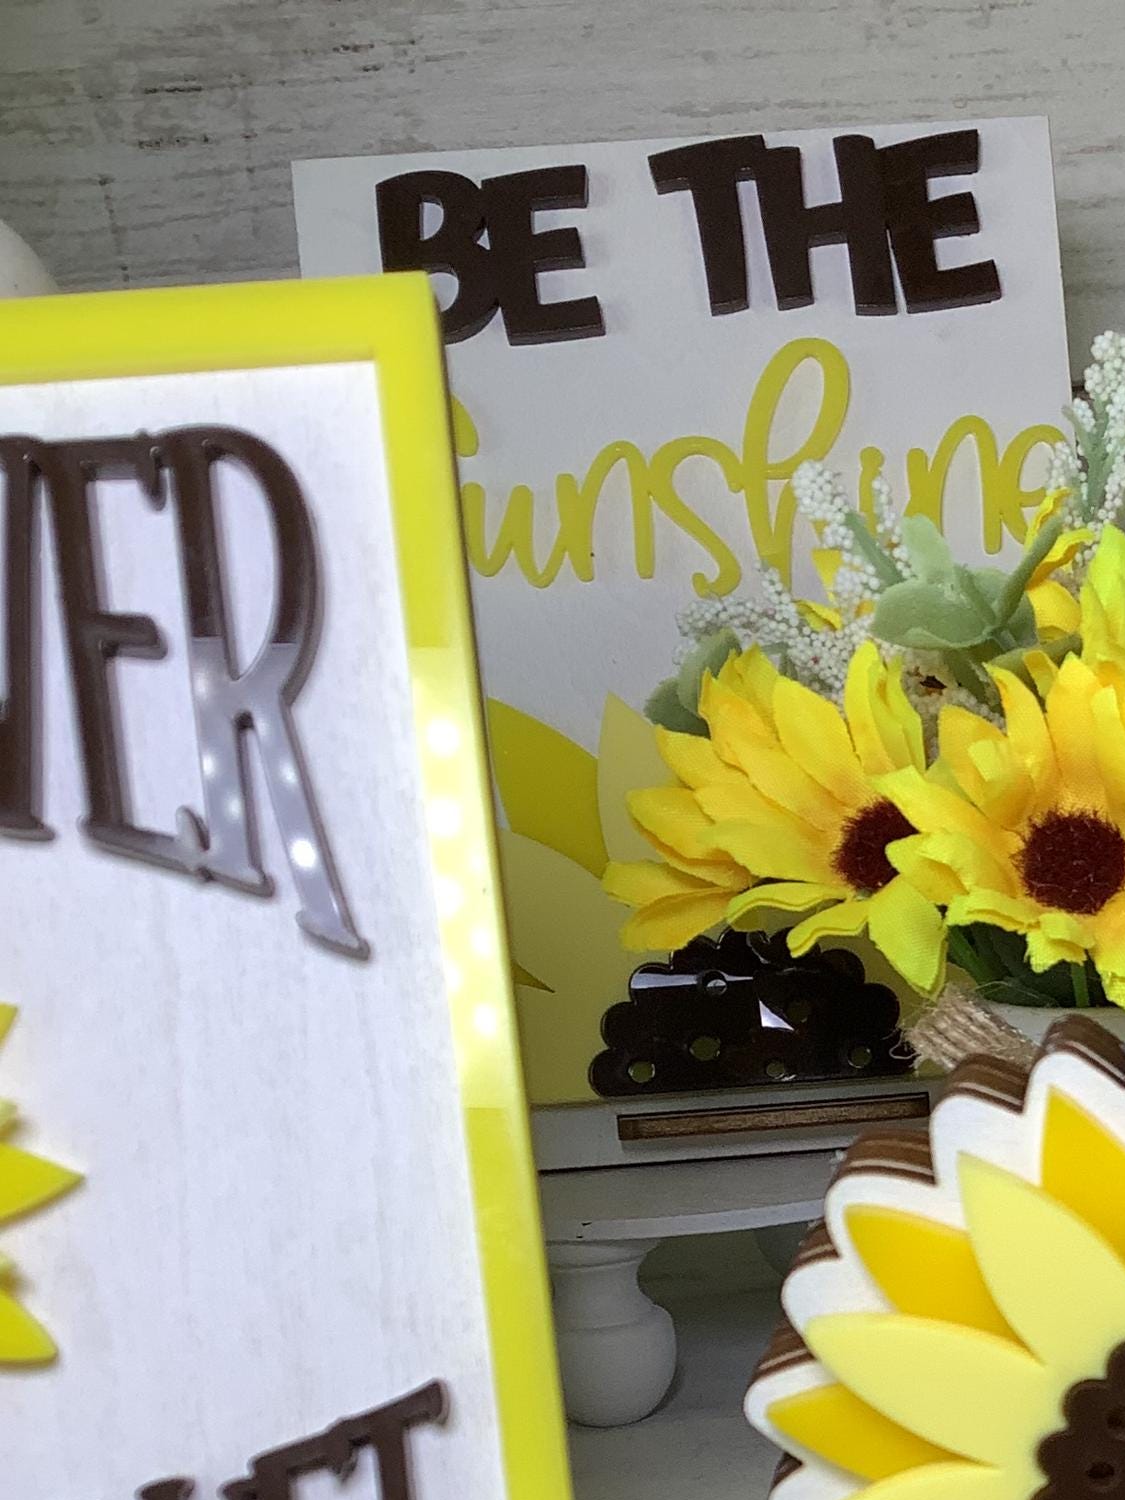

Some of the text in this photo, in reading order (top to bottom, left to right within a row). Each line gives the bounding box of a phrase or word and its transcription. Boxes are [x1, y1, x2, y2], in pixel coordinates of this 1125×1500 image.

[375, 129, 1002, 346] BE THE
[450, 337, 1068, 598] unshine
